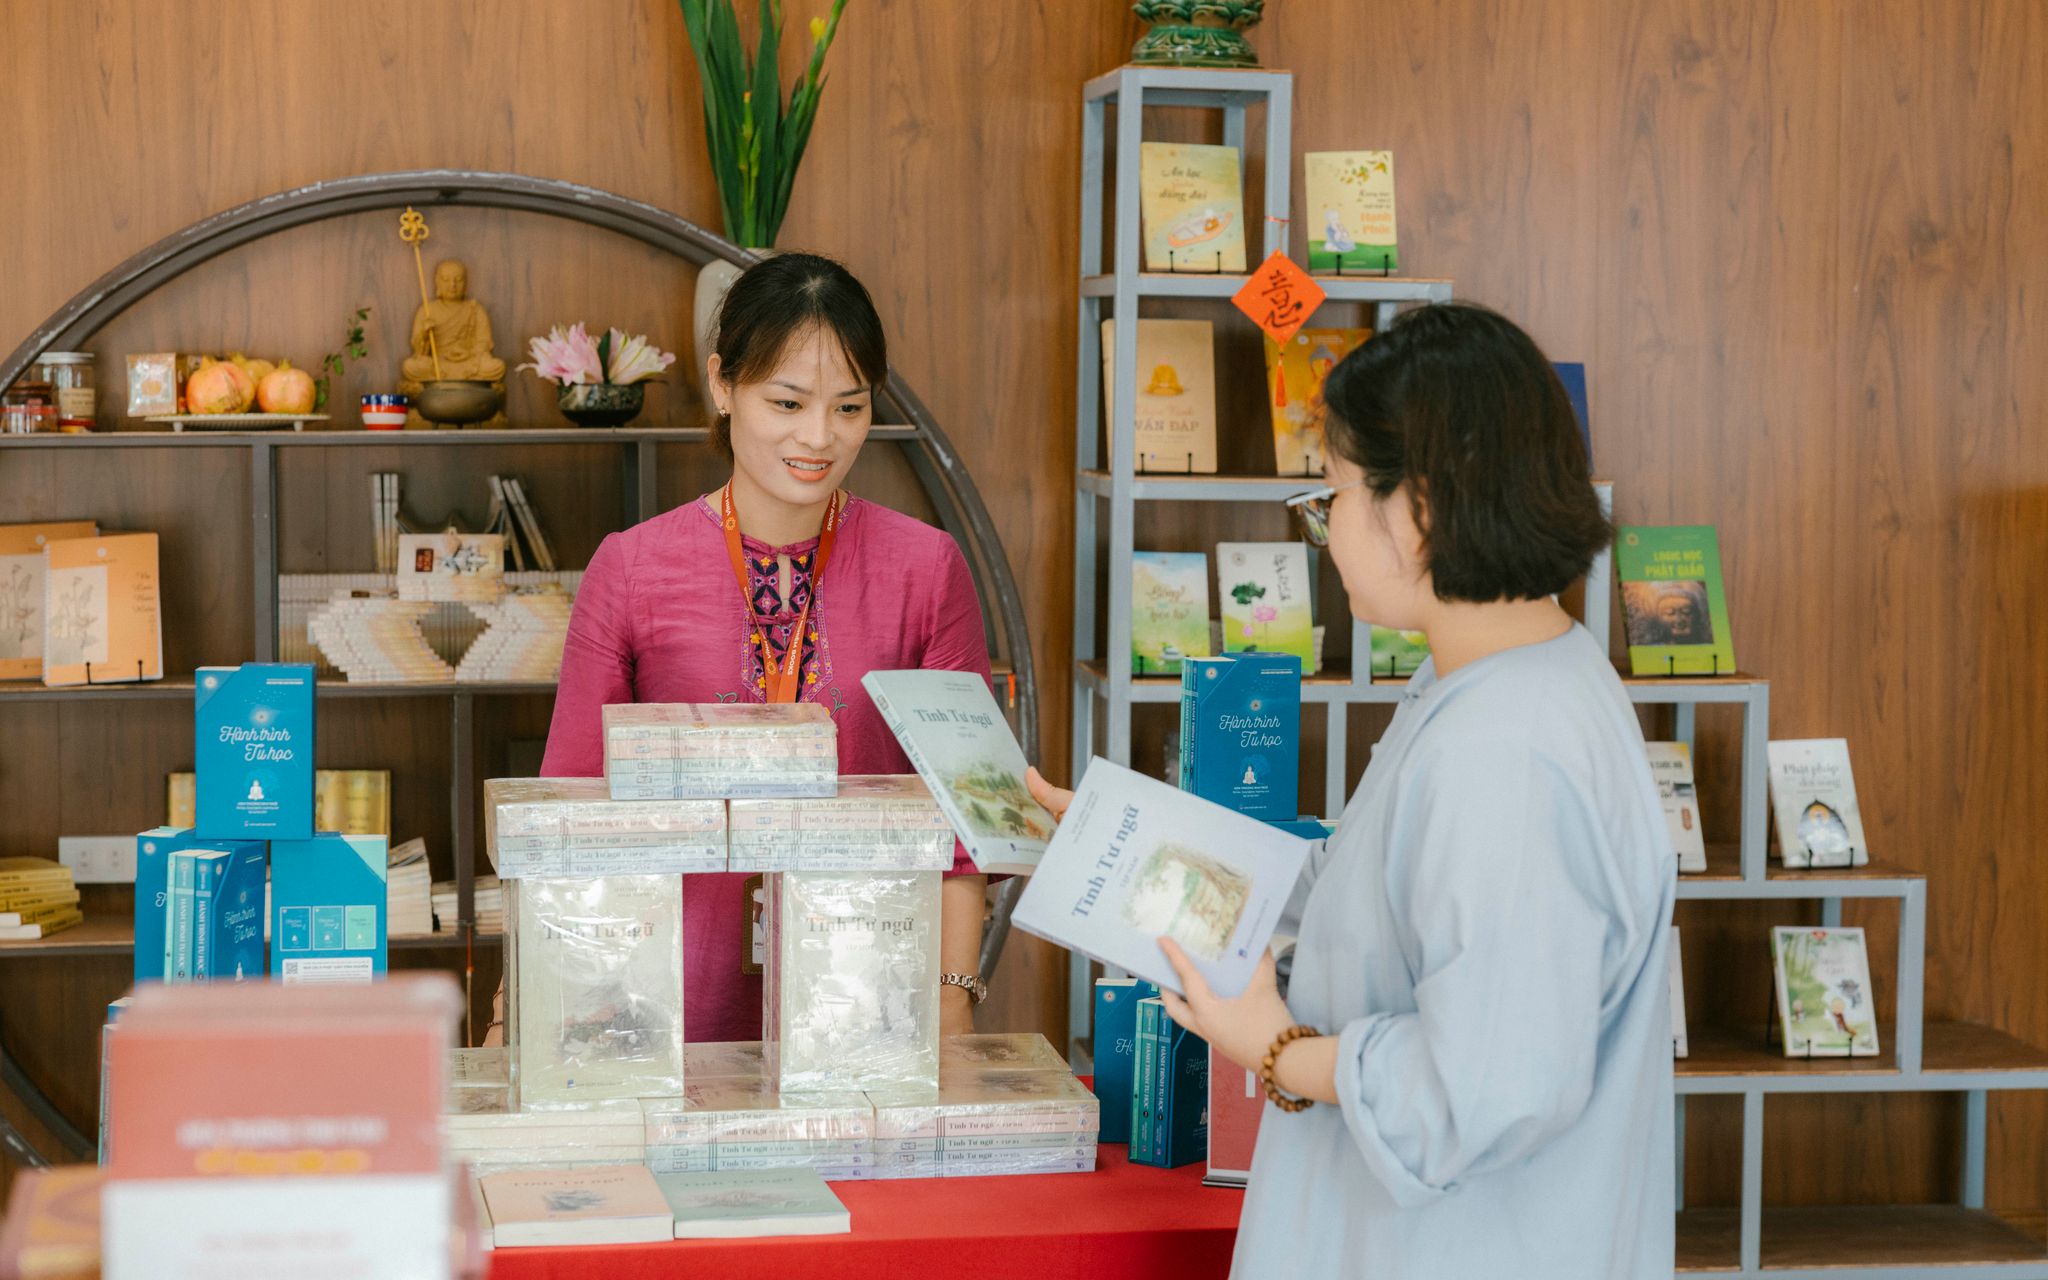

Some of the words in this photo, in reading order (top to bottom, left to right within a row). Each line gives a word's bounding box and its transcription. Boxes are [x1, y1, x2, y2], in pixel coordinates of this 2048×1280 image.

[787, 649, 797, 676] BOOKS
[1219, 715, 1252, 732] Hành
[1253, 715, 1280, 728] trình
[219, 726, 258, 744] Hành
[259, 727, 291, 741] trình
[1240, 731, 1259, 748] Tu
[1259, 734, 1282, 748] học
[245, 743, 266, 761] Tu
[267, 746, 293, 762] học
